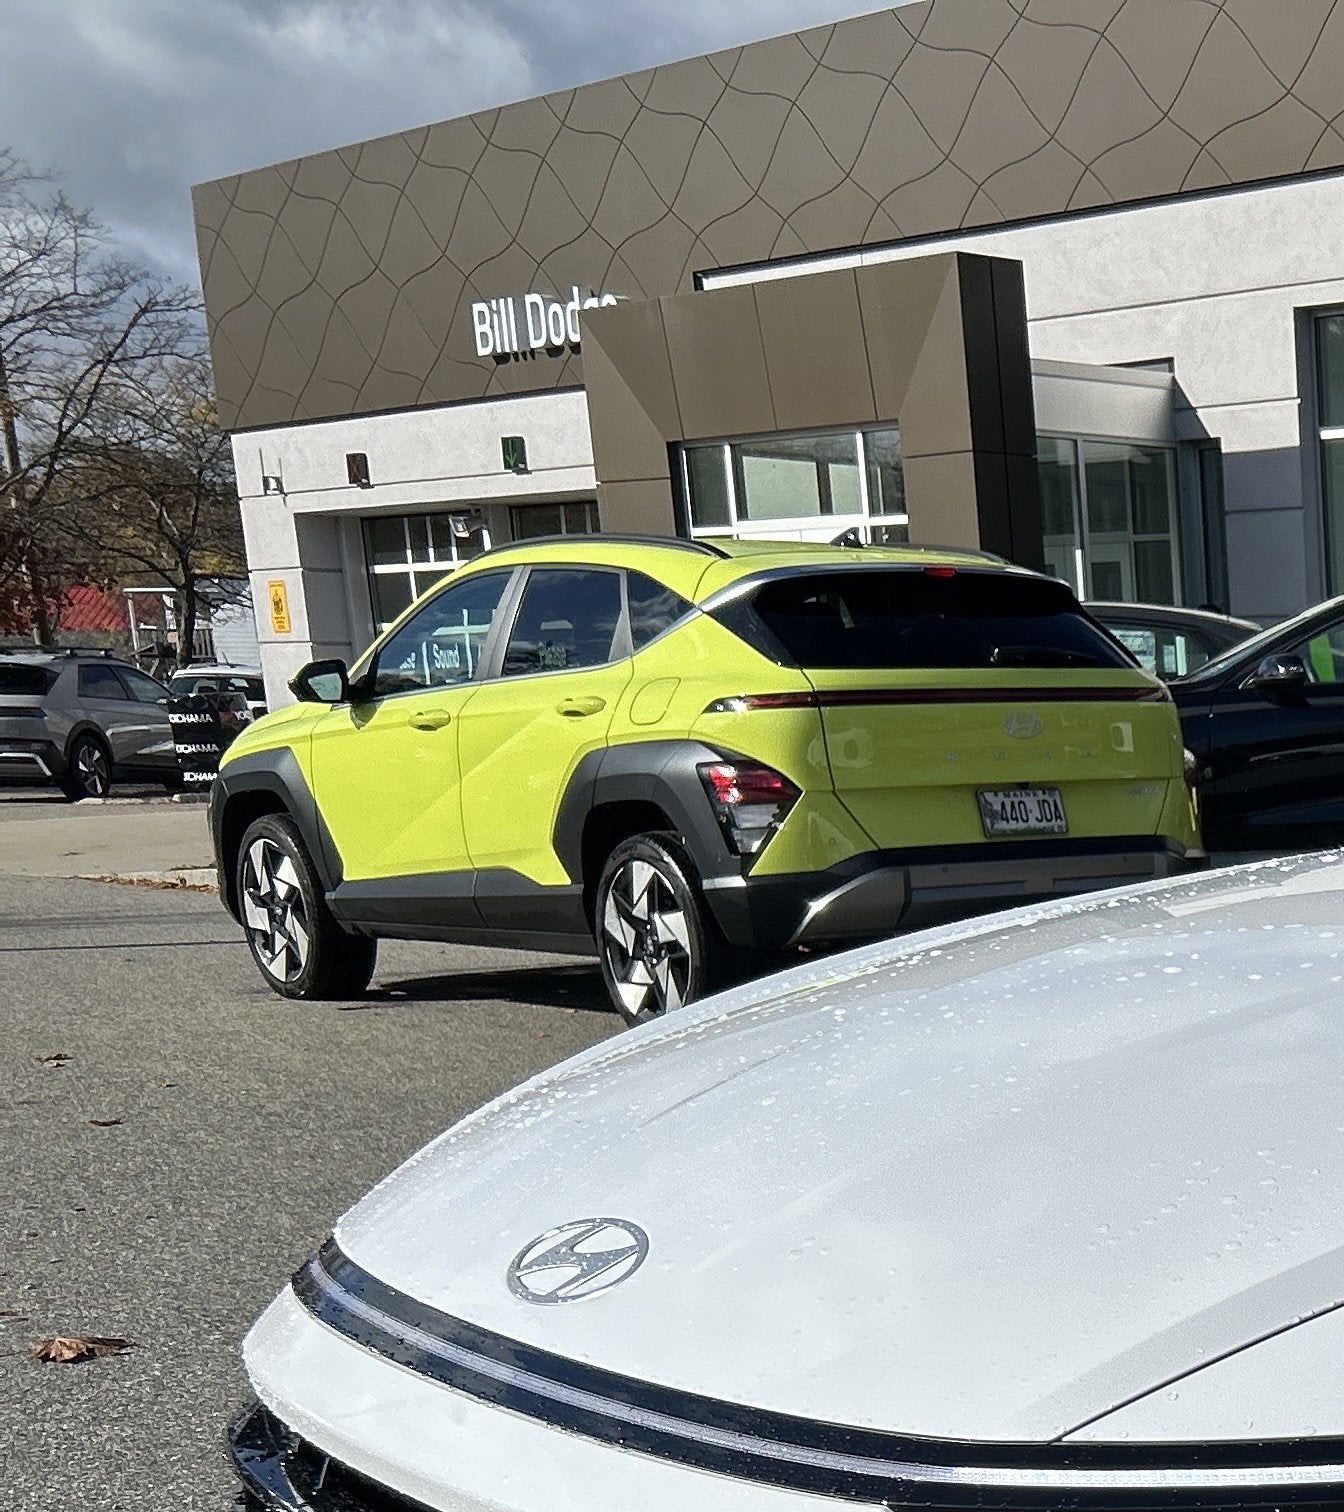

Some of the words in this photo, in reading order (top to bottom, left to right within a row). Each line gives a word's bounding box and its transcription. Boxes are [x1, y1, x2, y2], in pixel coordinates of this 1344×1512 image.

[472, 297, 518, 356] Bill
[525, 286, 617, 349] Dod
[1000, 800, 1029, 824] 440
